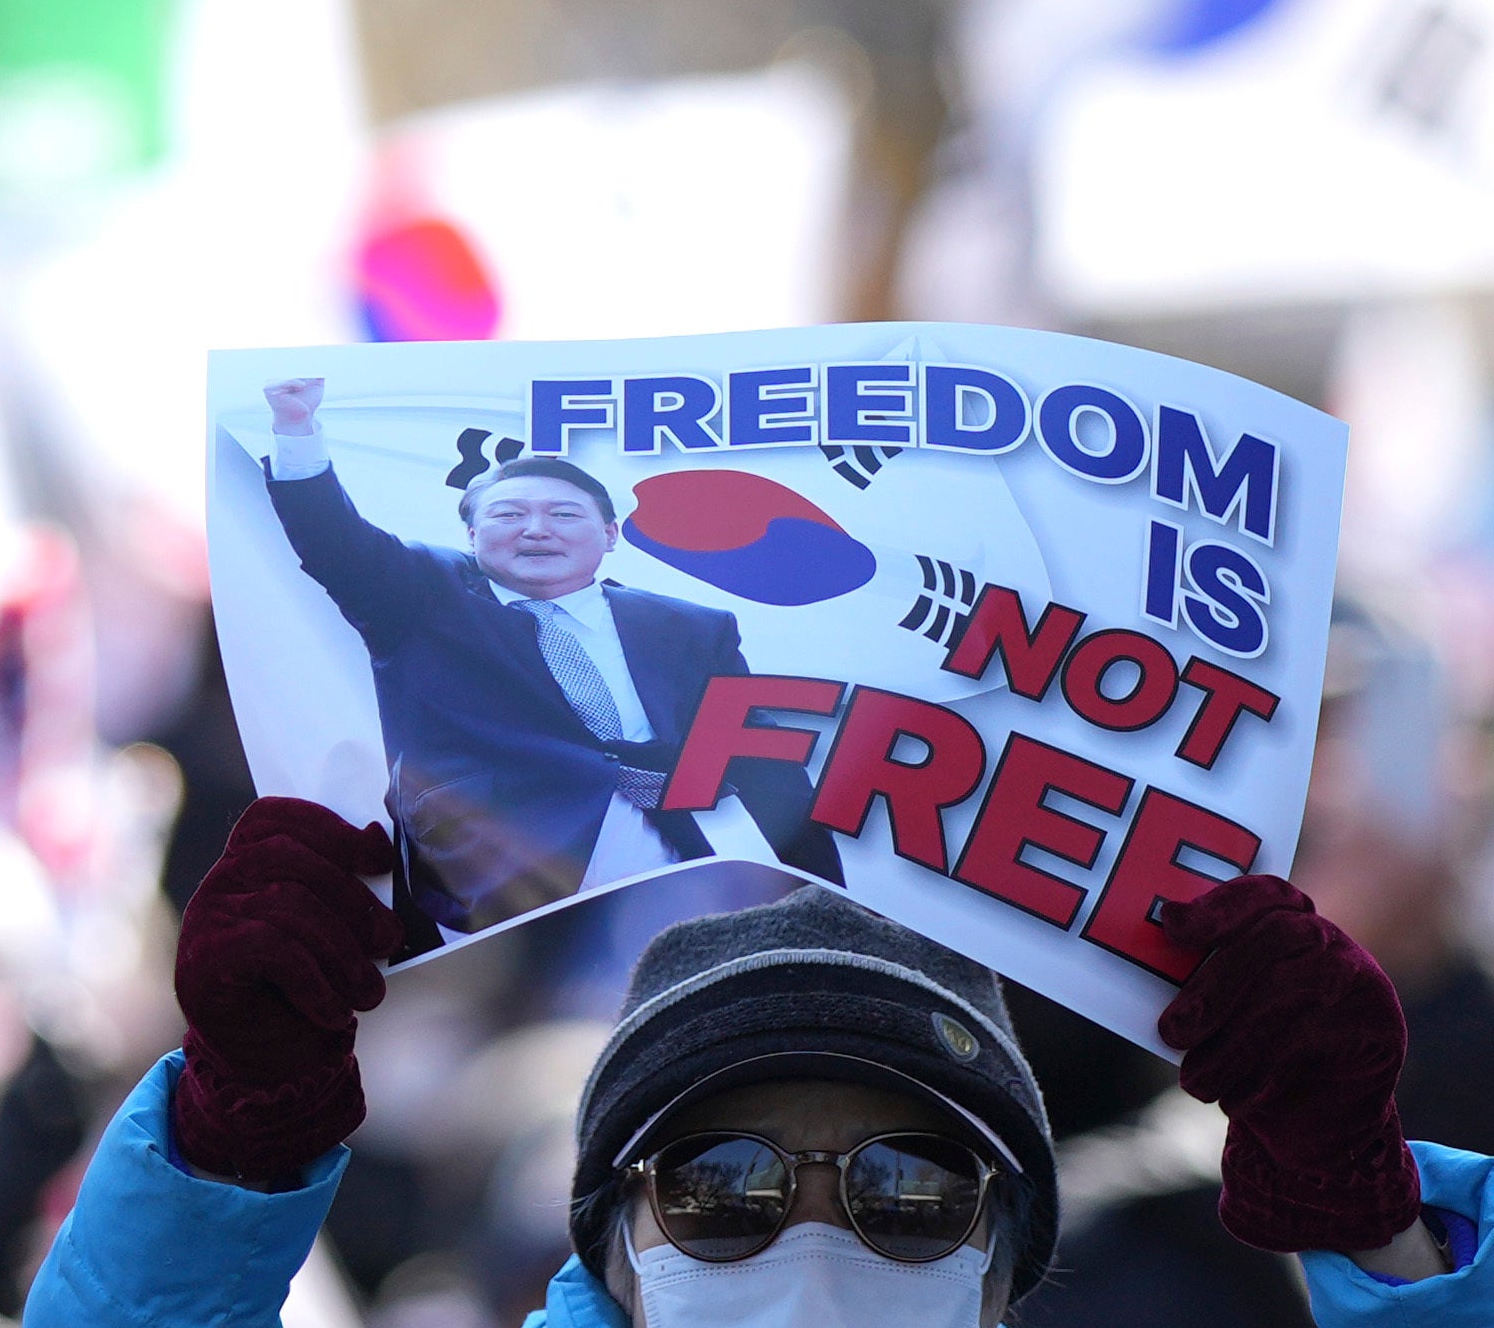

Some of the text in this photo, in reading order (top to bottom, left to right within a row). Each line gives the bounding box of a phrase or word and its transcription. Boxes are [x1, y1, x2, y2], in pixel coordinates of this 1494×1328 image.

[529, 362, 1279, 544] FREEDOM
[940, 583, 1280, 771] NOT
[1142, 519, 1270, 657] IS
[659, 674, 1262, 987] FREE
